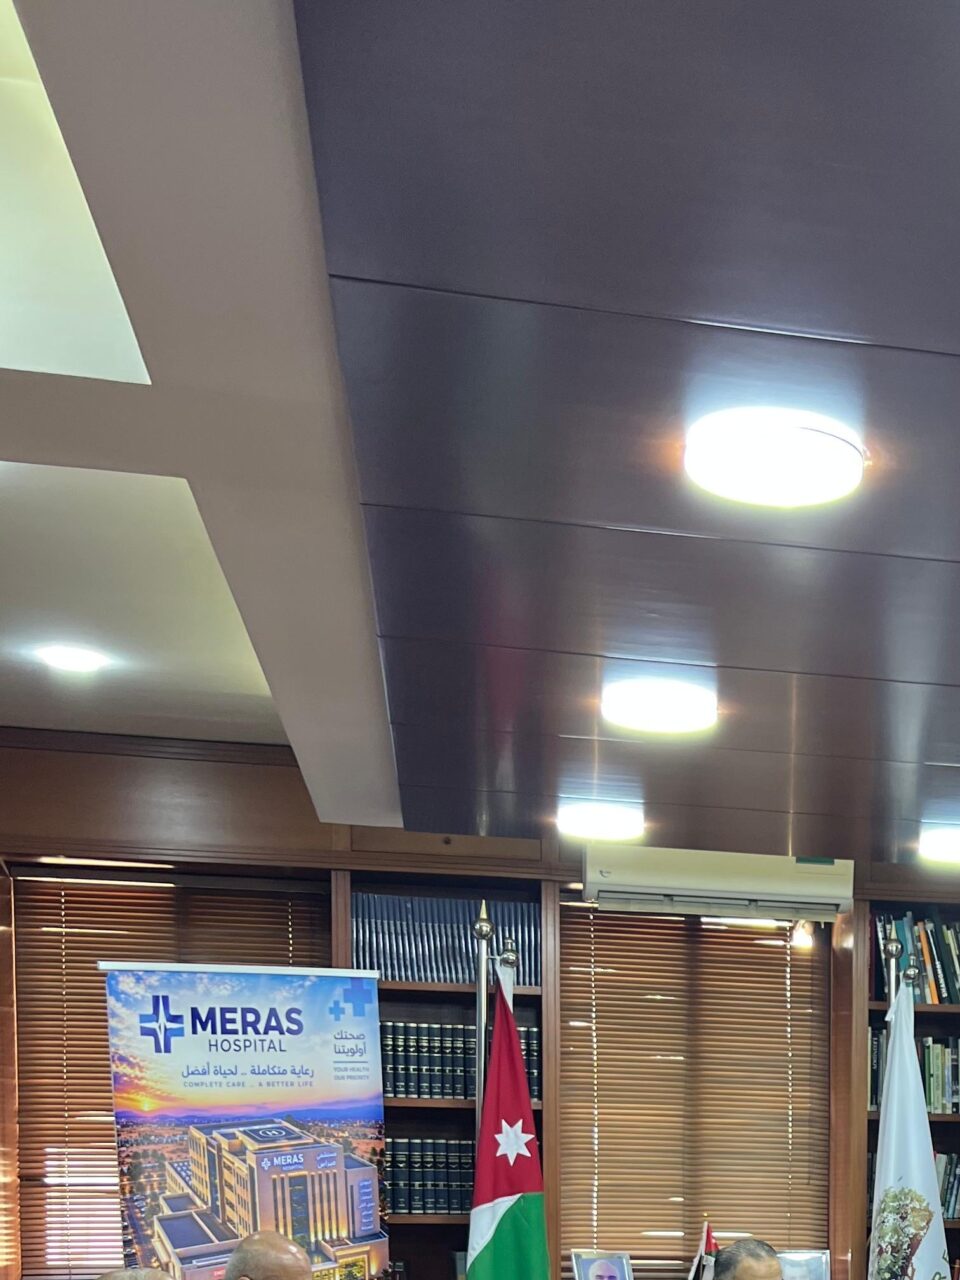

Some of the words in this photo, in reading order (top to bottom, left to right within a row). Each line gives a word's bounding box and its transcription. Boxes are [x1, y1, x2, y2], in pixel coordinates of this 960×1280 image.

[190, 1006, 304, 1036] MERAS
[333, 1029, 366, 1040] صحتك
[208, 1038, 287, 1053] HOSPITAL
[333, 1041, 367, 1057] أولويتنا
[181, 1061, 210, 1078] أفضل
[213, 1064, 238, 1079] لحياة
[250, 1064, 288, 1076] متكاملة
[290, 1064, 314, 1078] رعاية
[273, 1153, 304, 1166] MERAS
